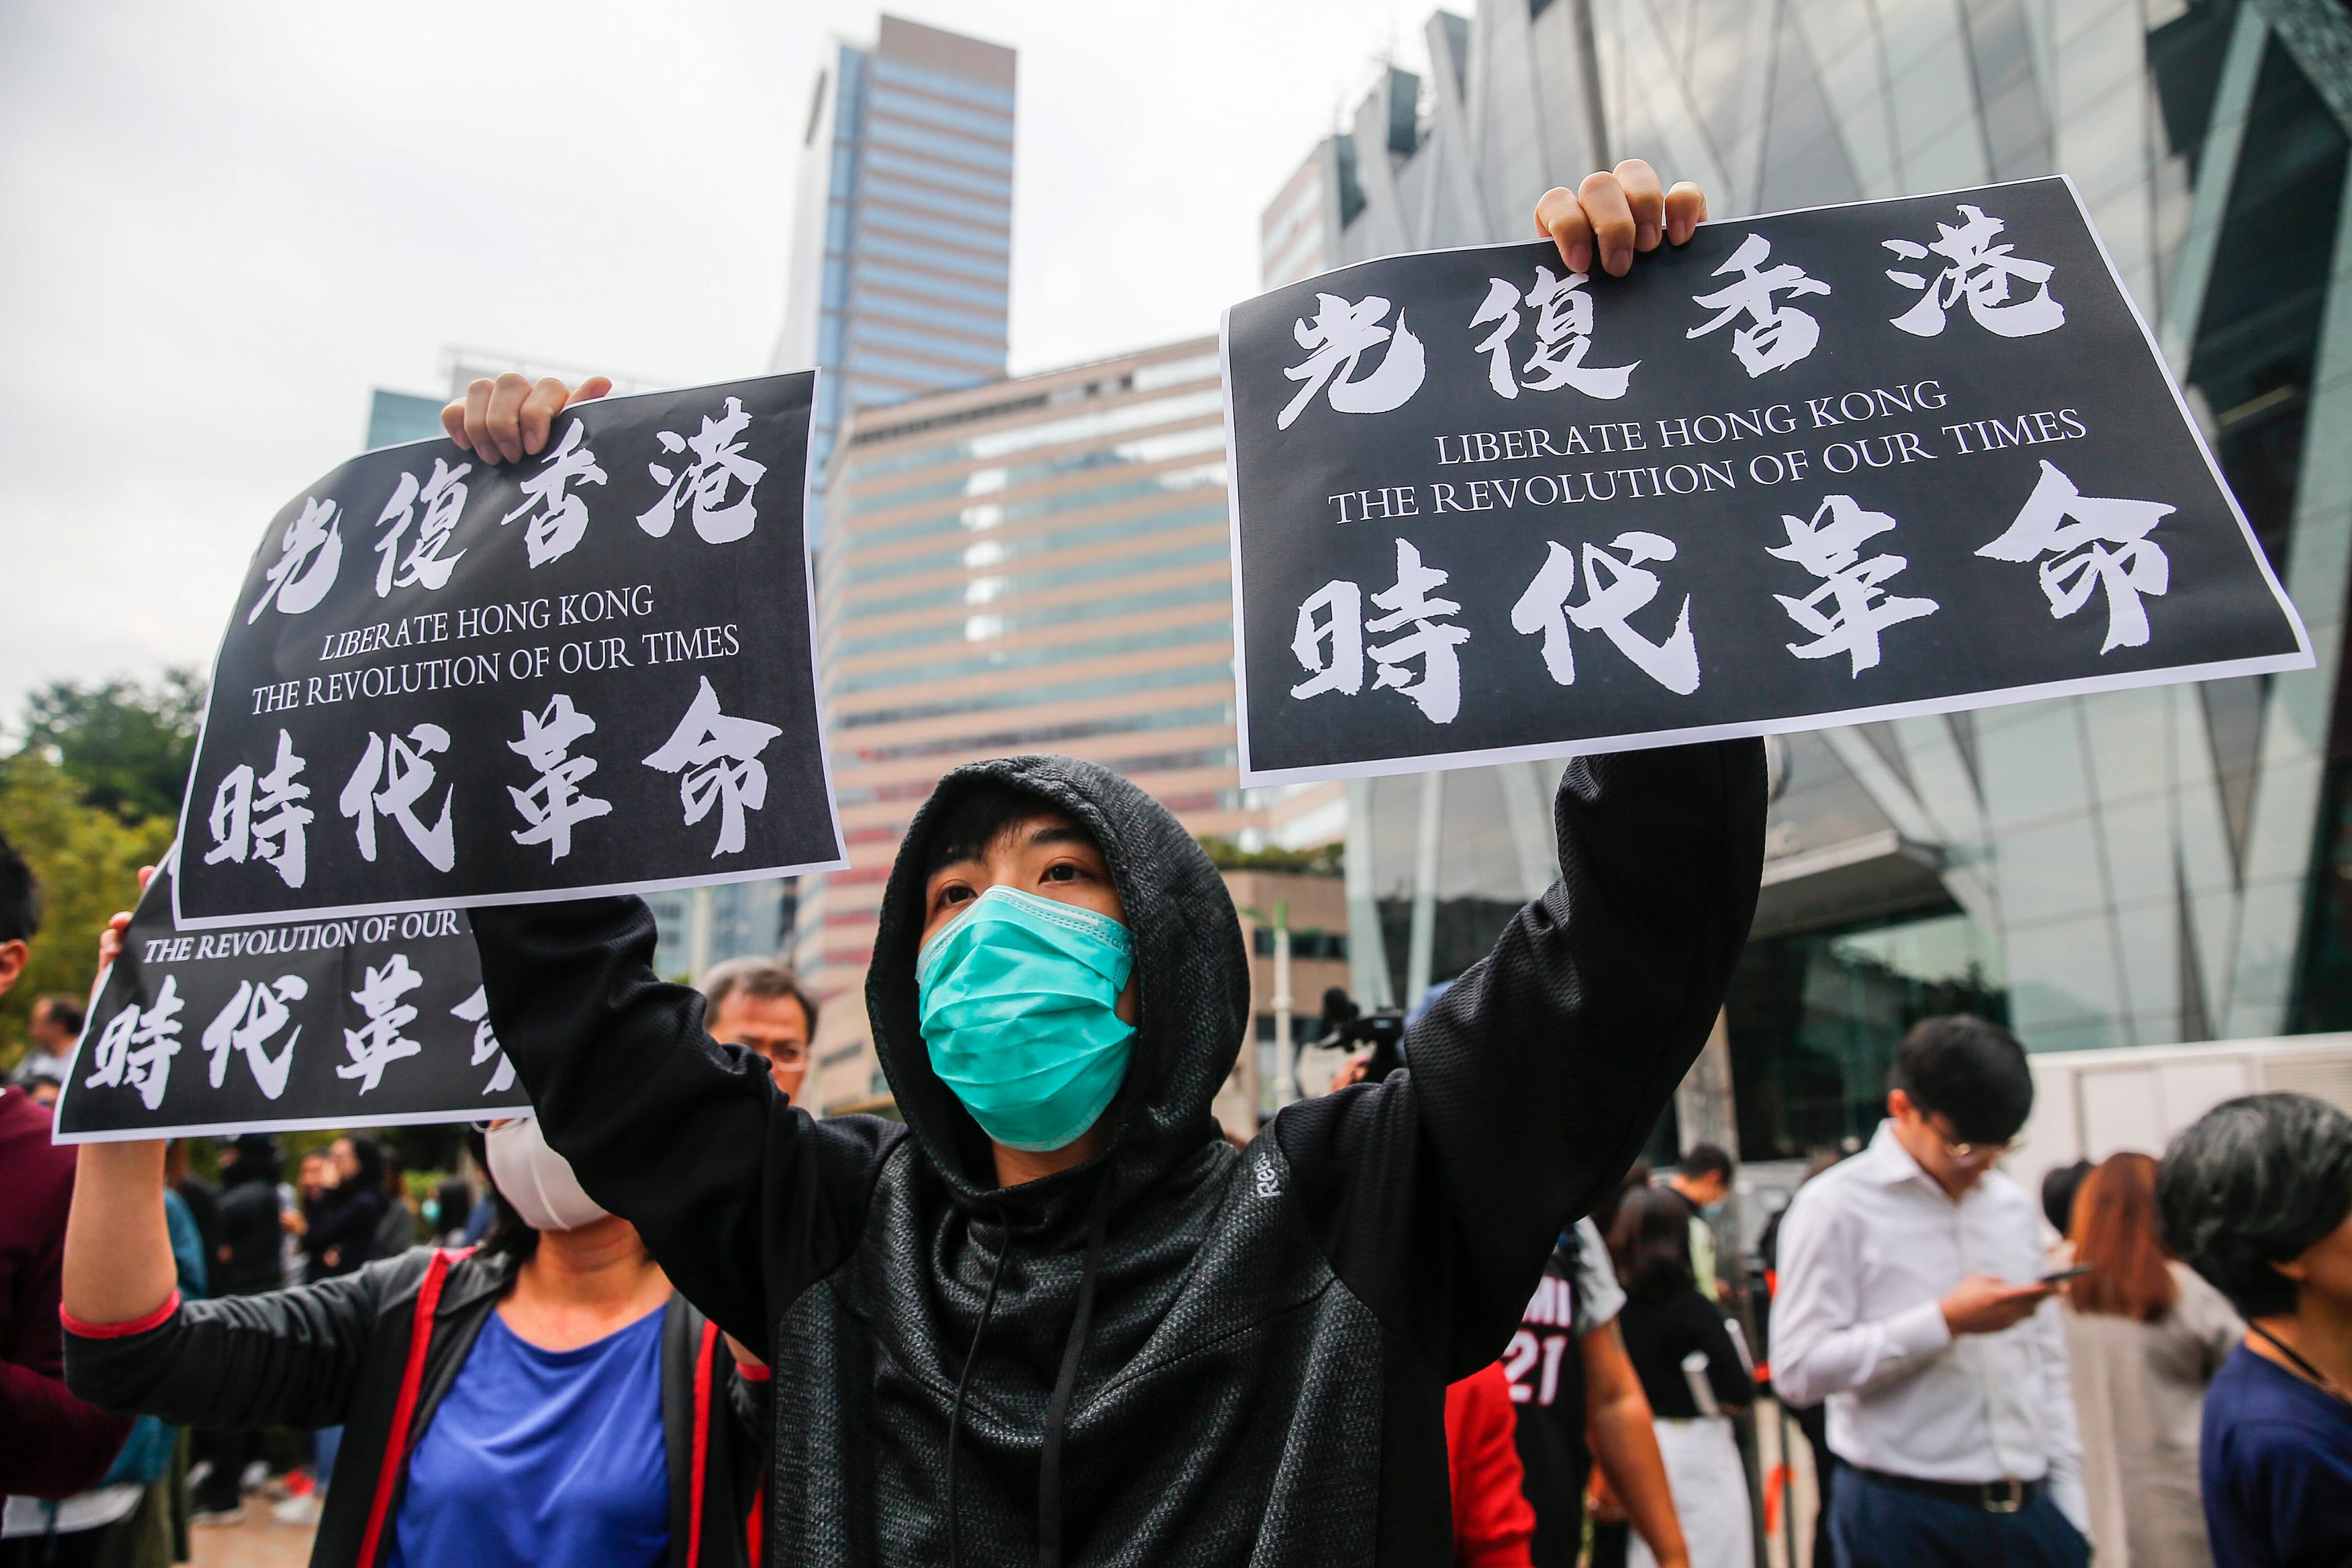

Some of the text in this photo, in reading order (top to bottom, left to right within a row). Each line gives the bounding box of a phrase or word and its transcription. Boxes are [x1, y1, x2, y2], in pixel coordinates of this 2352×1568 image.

[1277, 205, 2065, 431] 光復香港
[1328, 409, 2086, 524] THE REVOLUTION OF OUR TIMES
[1434, 380, 1947, 465] LIBERATE HONG KONG
[247, 396, 767, 625] 光復香港
[318, 584, 654, 661] LIBERATE HONG KONG
[1290, 459, 2177, 724] 時代革命
[252, 624, 740, 715] THE REVOLUTION OF OUR TIMES
[204, 676, 783, 888] 時代革命
[143, 909, 461, 963] THE REVOLUTION OF OUR
[1502, 1329, 1568, 1406] 21
